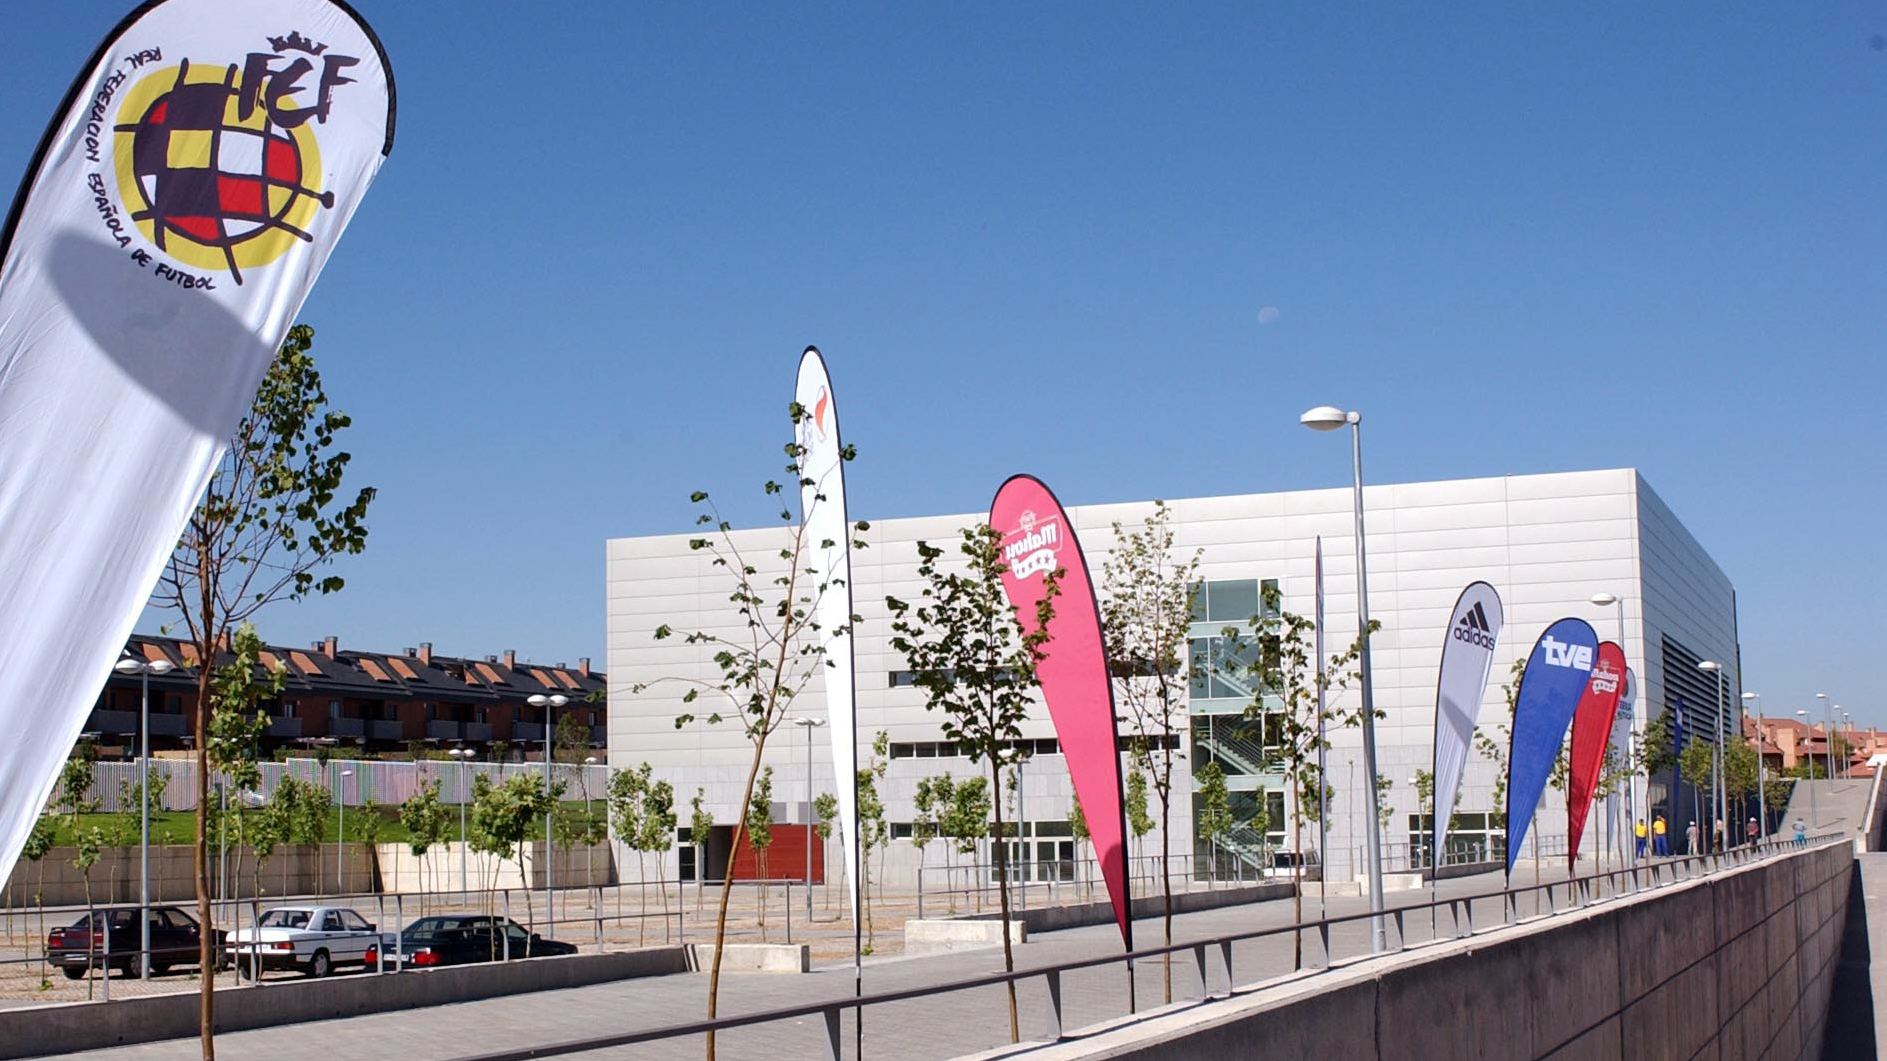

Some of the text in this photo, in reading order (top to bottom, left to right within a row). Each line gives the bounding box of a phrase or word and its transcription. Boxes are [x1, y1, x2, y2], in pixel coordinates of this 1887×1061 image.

[85, 46, 216, 290] REAL FEDERACION ESPAÑOLA DE FUTBOL
[1454, 627, 1496, 651] adidas
[1541, 635, 1593, 671] tve
